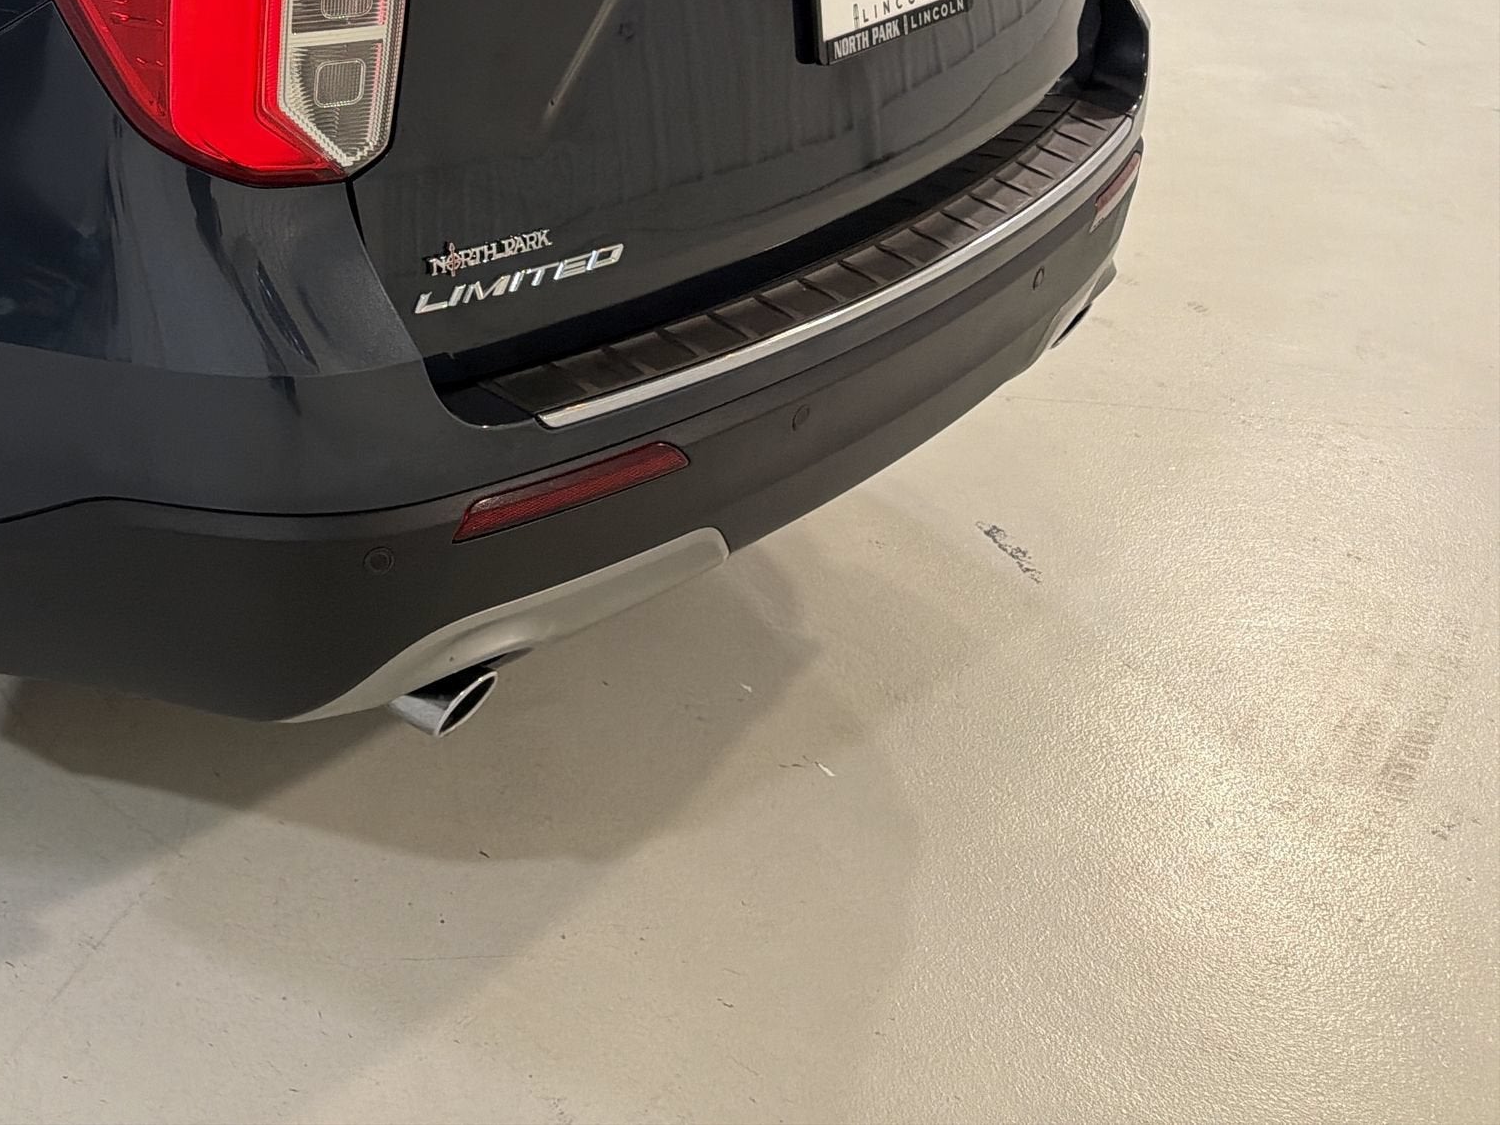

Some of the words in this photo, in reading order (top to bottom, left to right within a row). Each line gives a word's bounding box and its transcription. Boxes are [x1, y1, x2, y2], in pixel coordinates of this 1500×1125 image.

[833, 30, 870, 60] NORTH
[871, 19, 901, 46] PARK
[429, 242, 499, 277] NORTH
[501, 229, 553, 256] PARK
[414, 242, 625, 314] LIMITED
